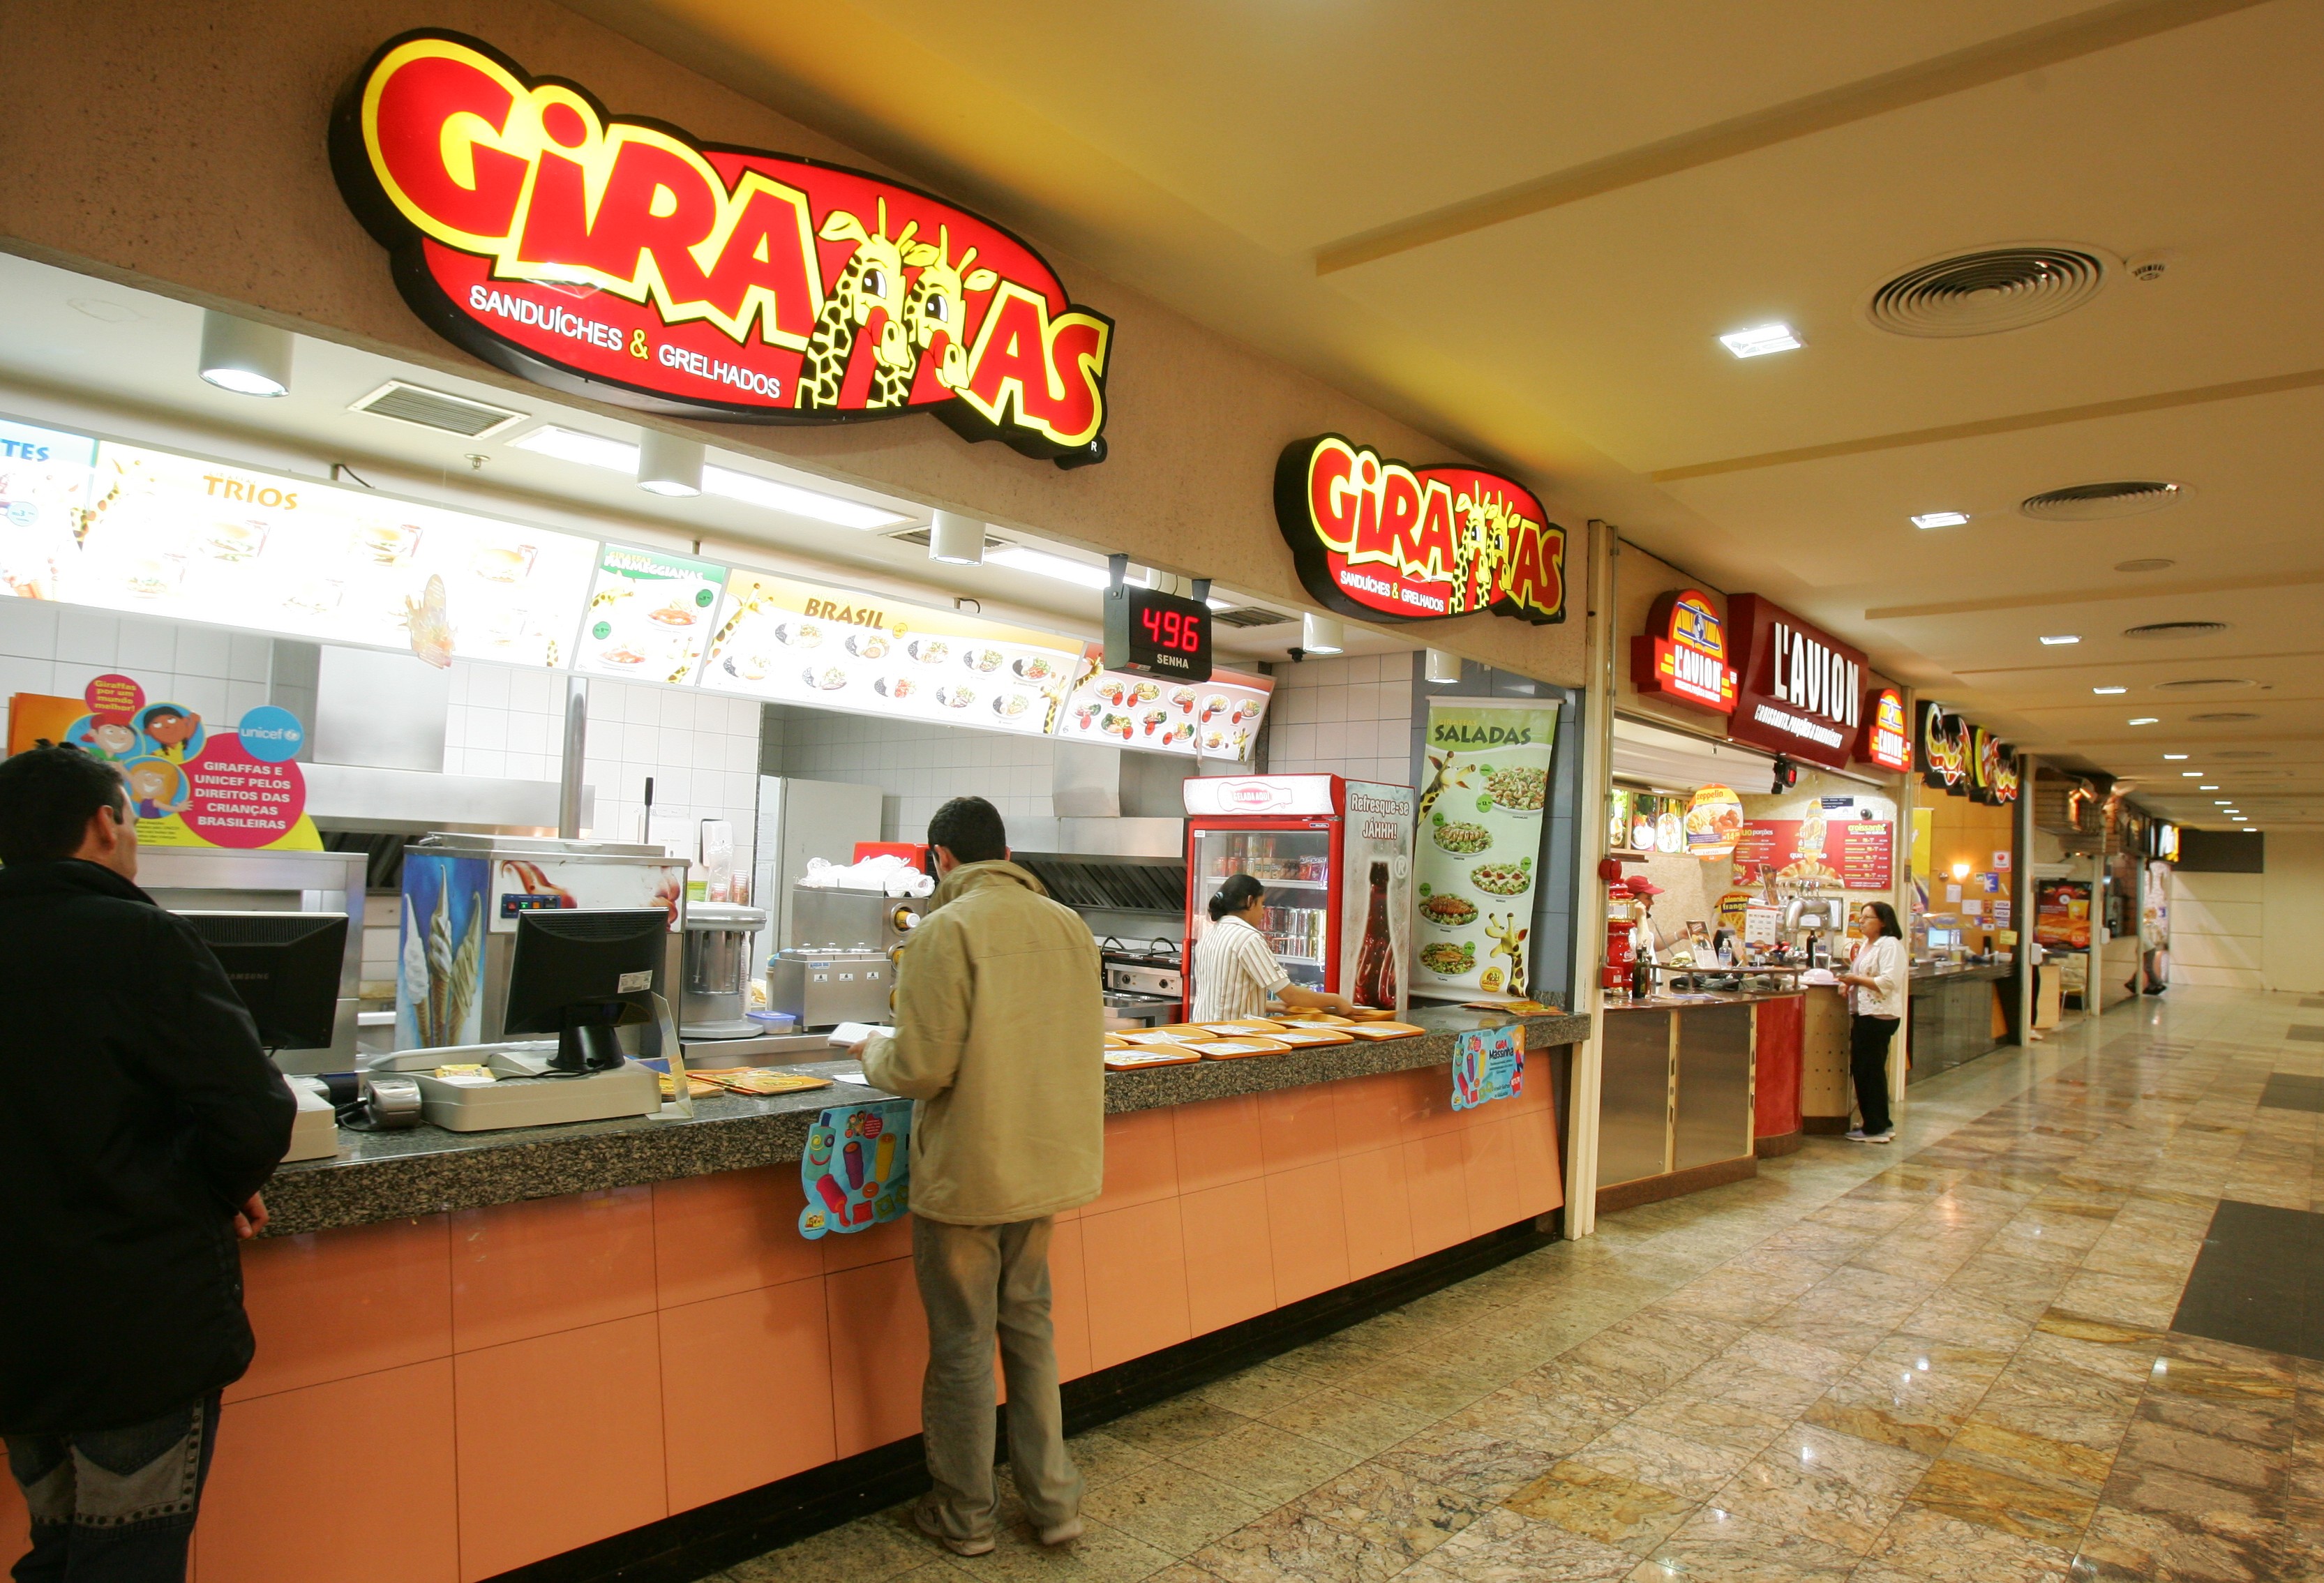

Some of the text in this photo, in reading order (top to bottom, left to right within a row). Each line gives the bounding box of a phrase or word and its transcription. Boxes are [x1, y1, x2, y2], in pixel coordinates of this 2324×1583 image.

[468, 284, 781, 400] SANDUÍCHES & GRELHADOS
[202, 474, 298, 511] TRIOS
[1340, 570, 1444, 613] SANDUÍCHES & GRELHADOS
[804, 597, 883, 630] BRASIL
[1142, 607, 1200, 652] 496
[1157, 654, 1190, 669] SENHA
[1674, 644, 1723, 693] L'AVION
[1773, 622, 1859, 728] L'AVION
[95, 680, 137, 691] Giraffas
[94, 703, 136, 712] melhor!
[96, 696, 134, 705] mundo
[240, 726, 284, 740] unicef
[1434, 724, 1531, 745] SALADAS
[203, 761, 283, 776] GIRAFFAS E
[194, 774, 291, 790] UNICEF PELOS
[194, 788, 290, 803] DIREITOS DAS
[1233, 791, 1270, 802] GELADA AQUI
[206, 802, 278, 816] CRIANÇAS
[1350, 793, 1409, 818] Refresque-se
[197, 816, 287, 830] BRASILEIRAS
[1361, 816, 1398, 840] JÁHHH!
[1489, 1046, 1514, 1060] Massinha
